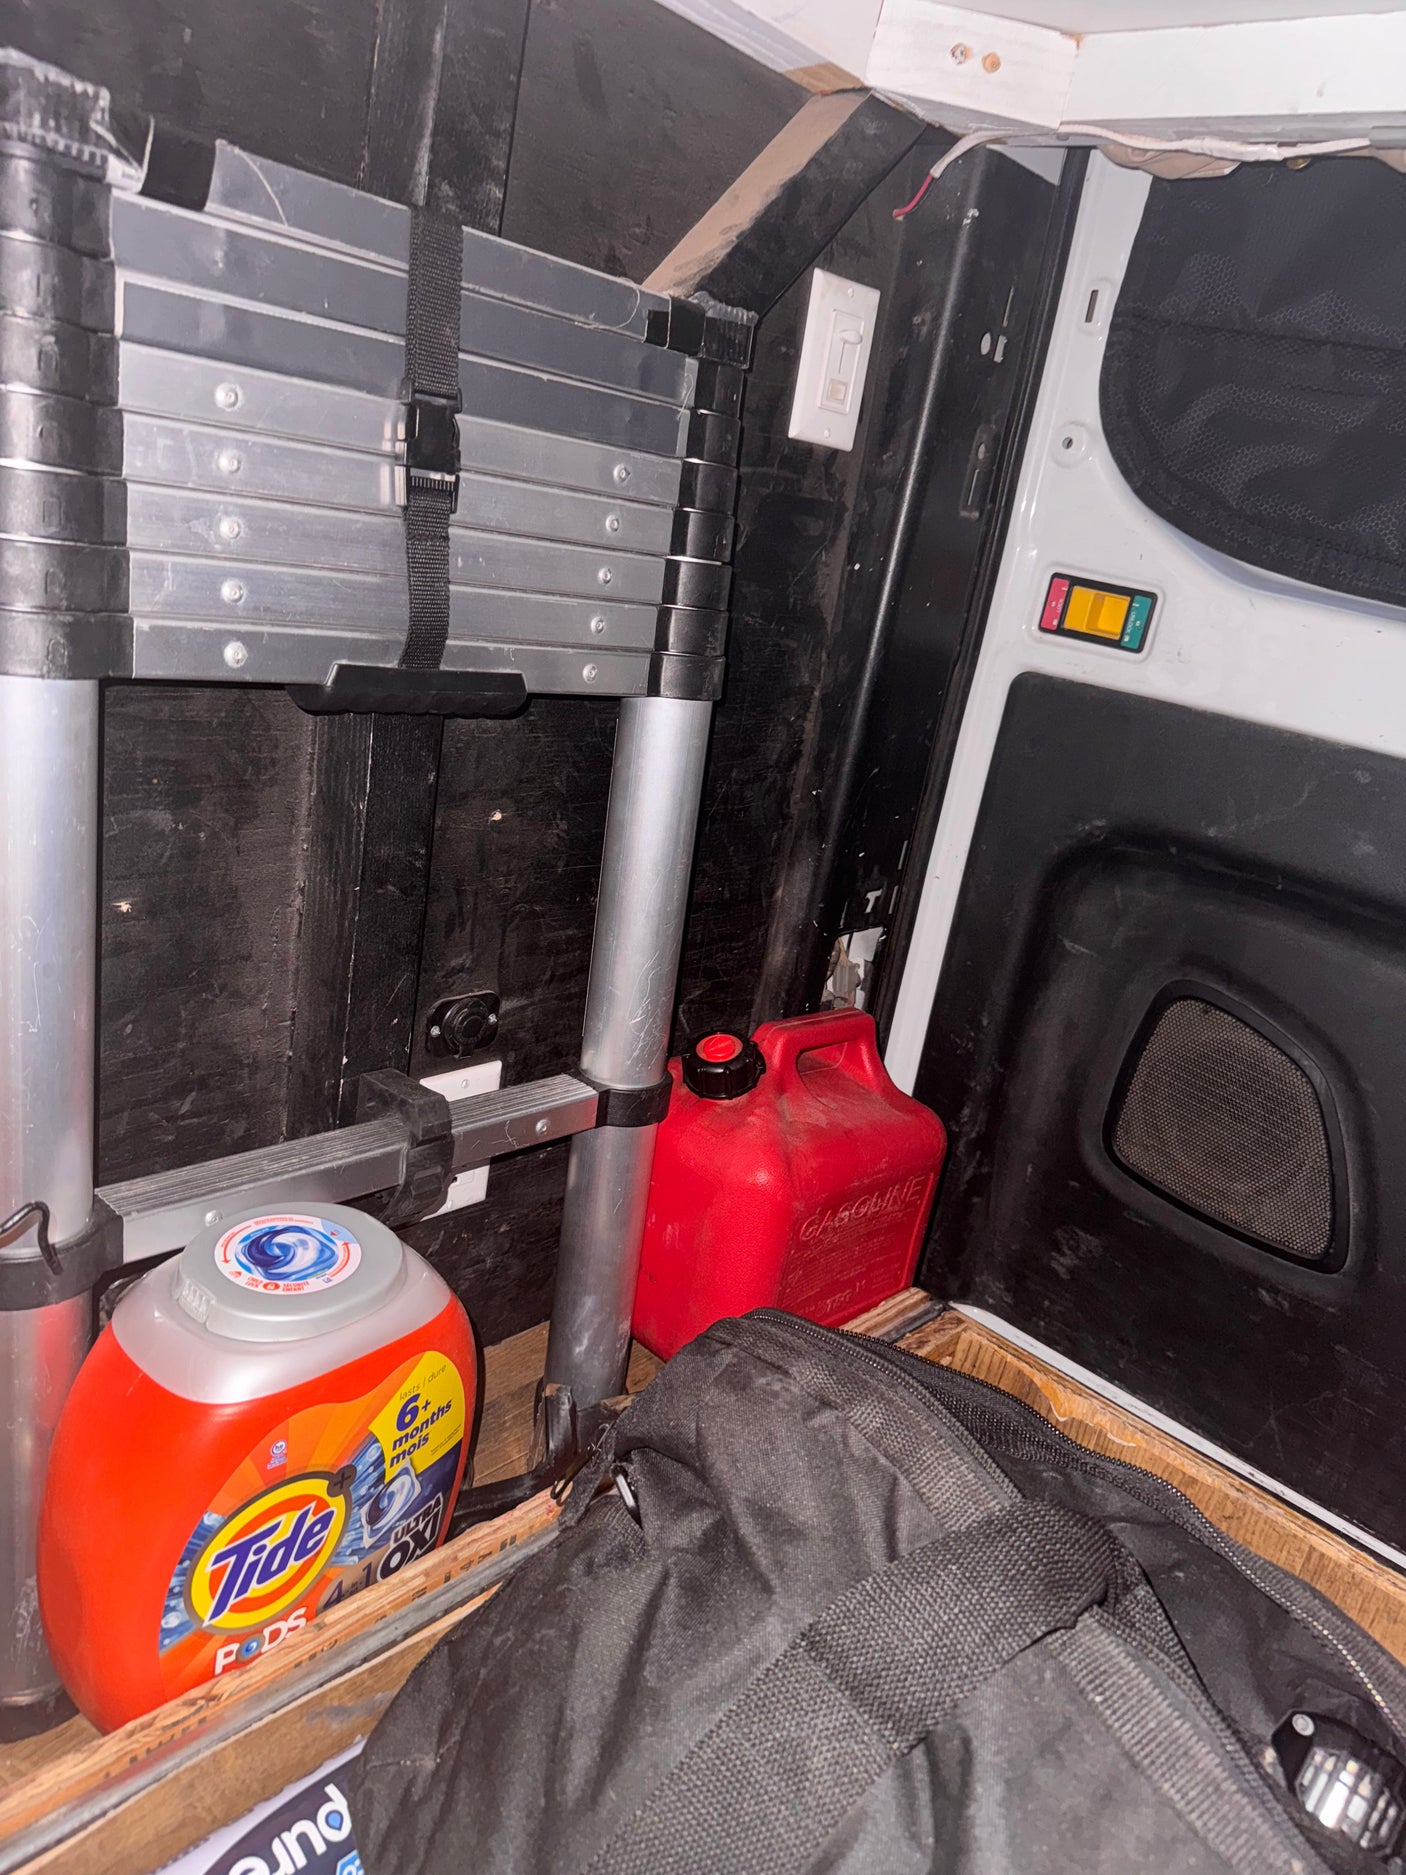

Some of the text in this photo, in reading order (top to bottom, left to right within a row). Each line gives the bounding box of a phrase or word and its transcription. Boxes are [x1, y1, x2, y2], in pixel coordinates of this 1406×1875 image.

[800, 1176, 925, 1240] GASOLINE
[400, 1383, 421, 1401] lasts
[427, 1364, 447, 1383] dure
[389, 1433, 430, 1468] mois
[392, 1400, 452, 1451] months
[379, 1505, 441, 1580] OXI
[393, 1497, 441, 1541] ULTRA
[205, 1501, 336, 1626] Tide
[214, 1607, 307, 1676] PODS
